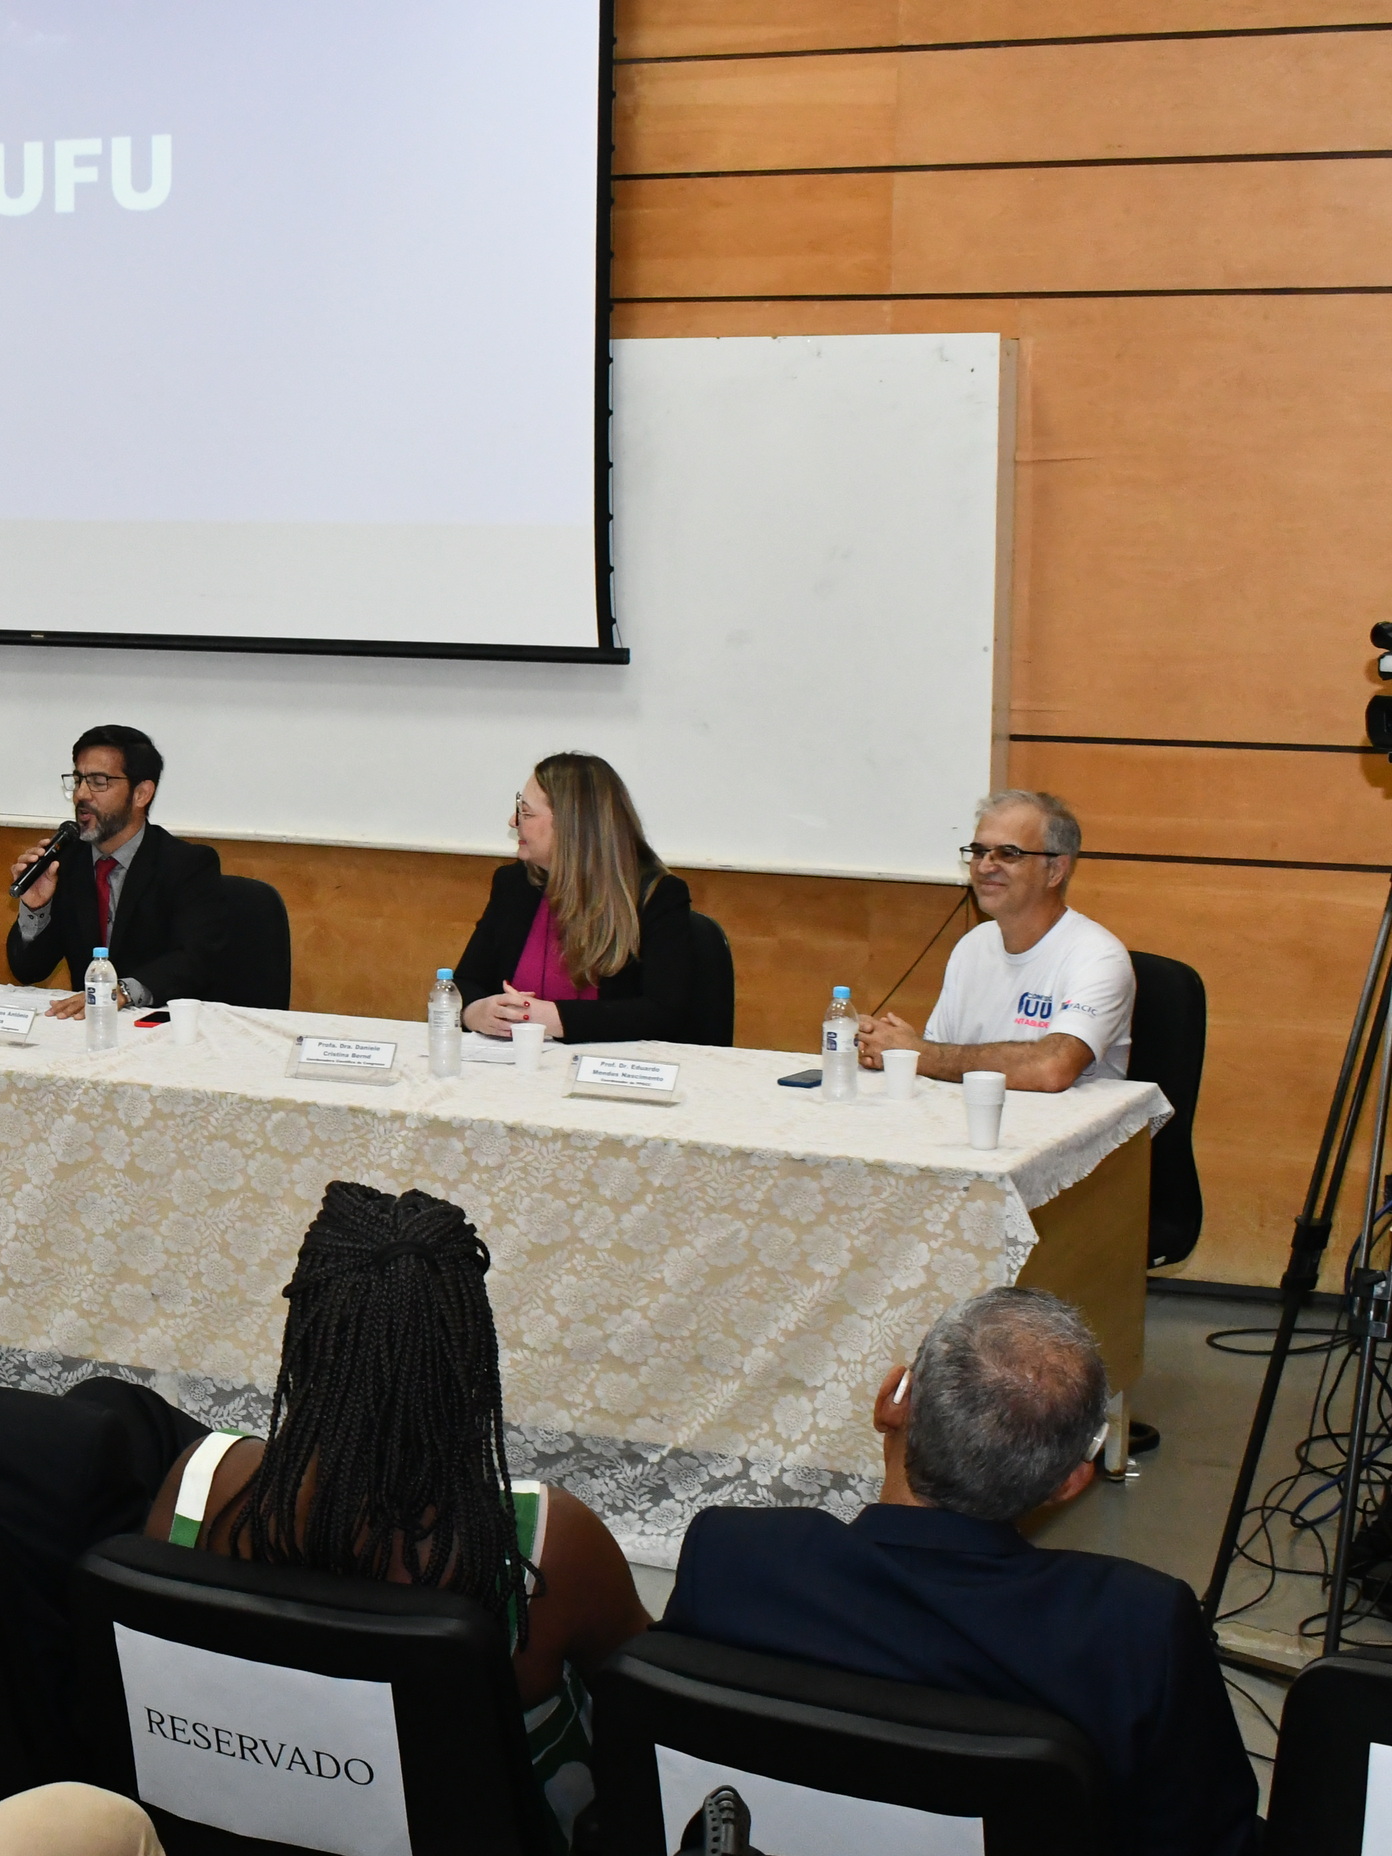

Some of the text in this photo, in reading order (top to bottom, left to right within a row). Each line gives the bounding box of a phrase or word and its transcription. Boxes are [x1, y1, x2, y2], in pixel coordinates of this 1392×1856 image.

[631, 1064, 660, 1072] Eduardo
[621, 1072, 664, 1082] Nascimento
[144, 1706, 375, 1786] RESERVADO
